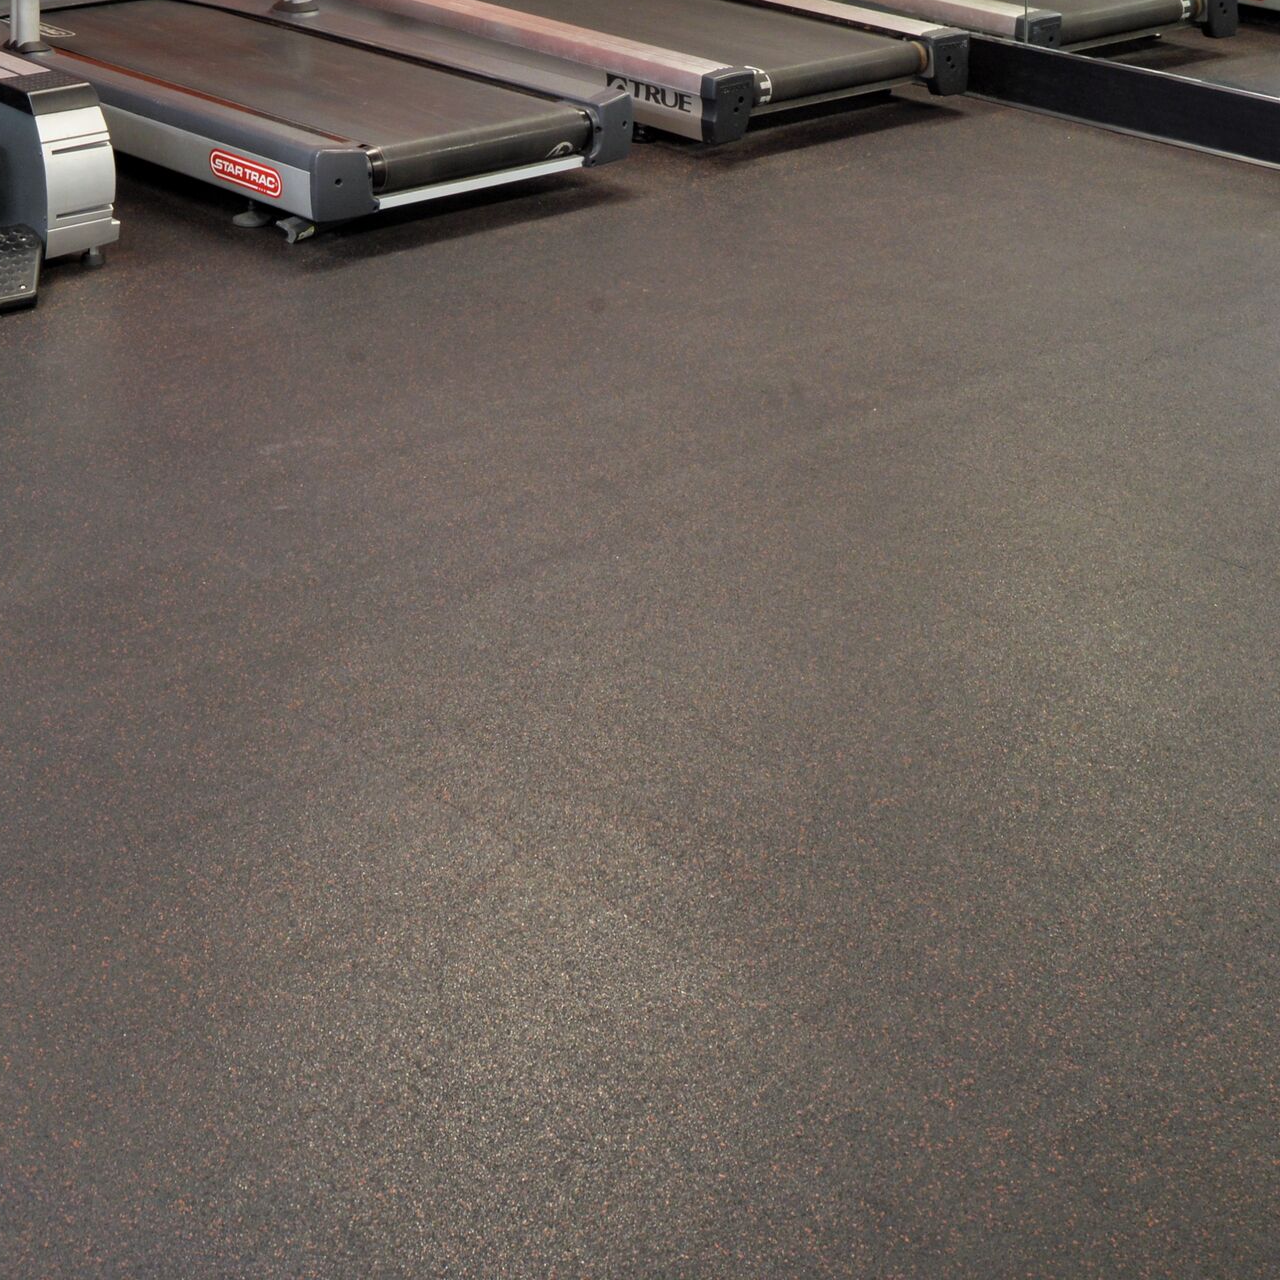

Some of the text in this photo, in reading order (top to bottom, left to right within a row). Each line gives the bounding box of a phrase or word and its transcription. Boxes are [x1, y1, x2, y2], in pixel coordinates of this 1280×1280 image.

[629, 79, 693, 113] TRUE
[213, 158, 275, 188] STAR TRAC
